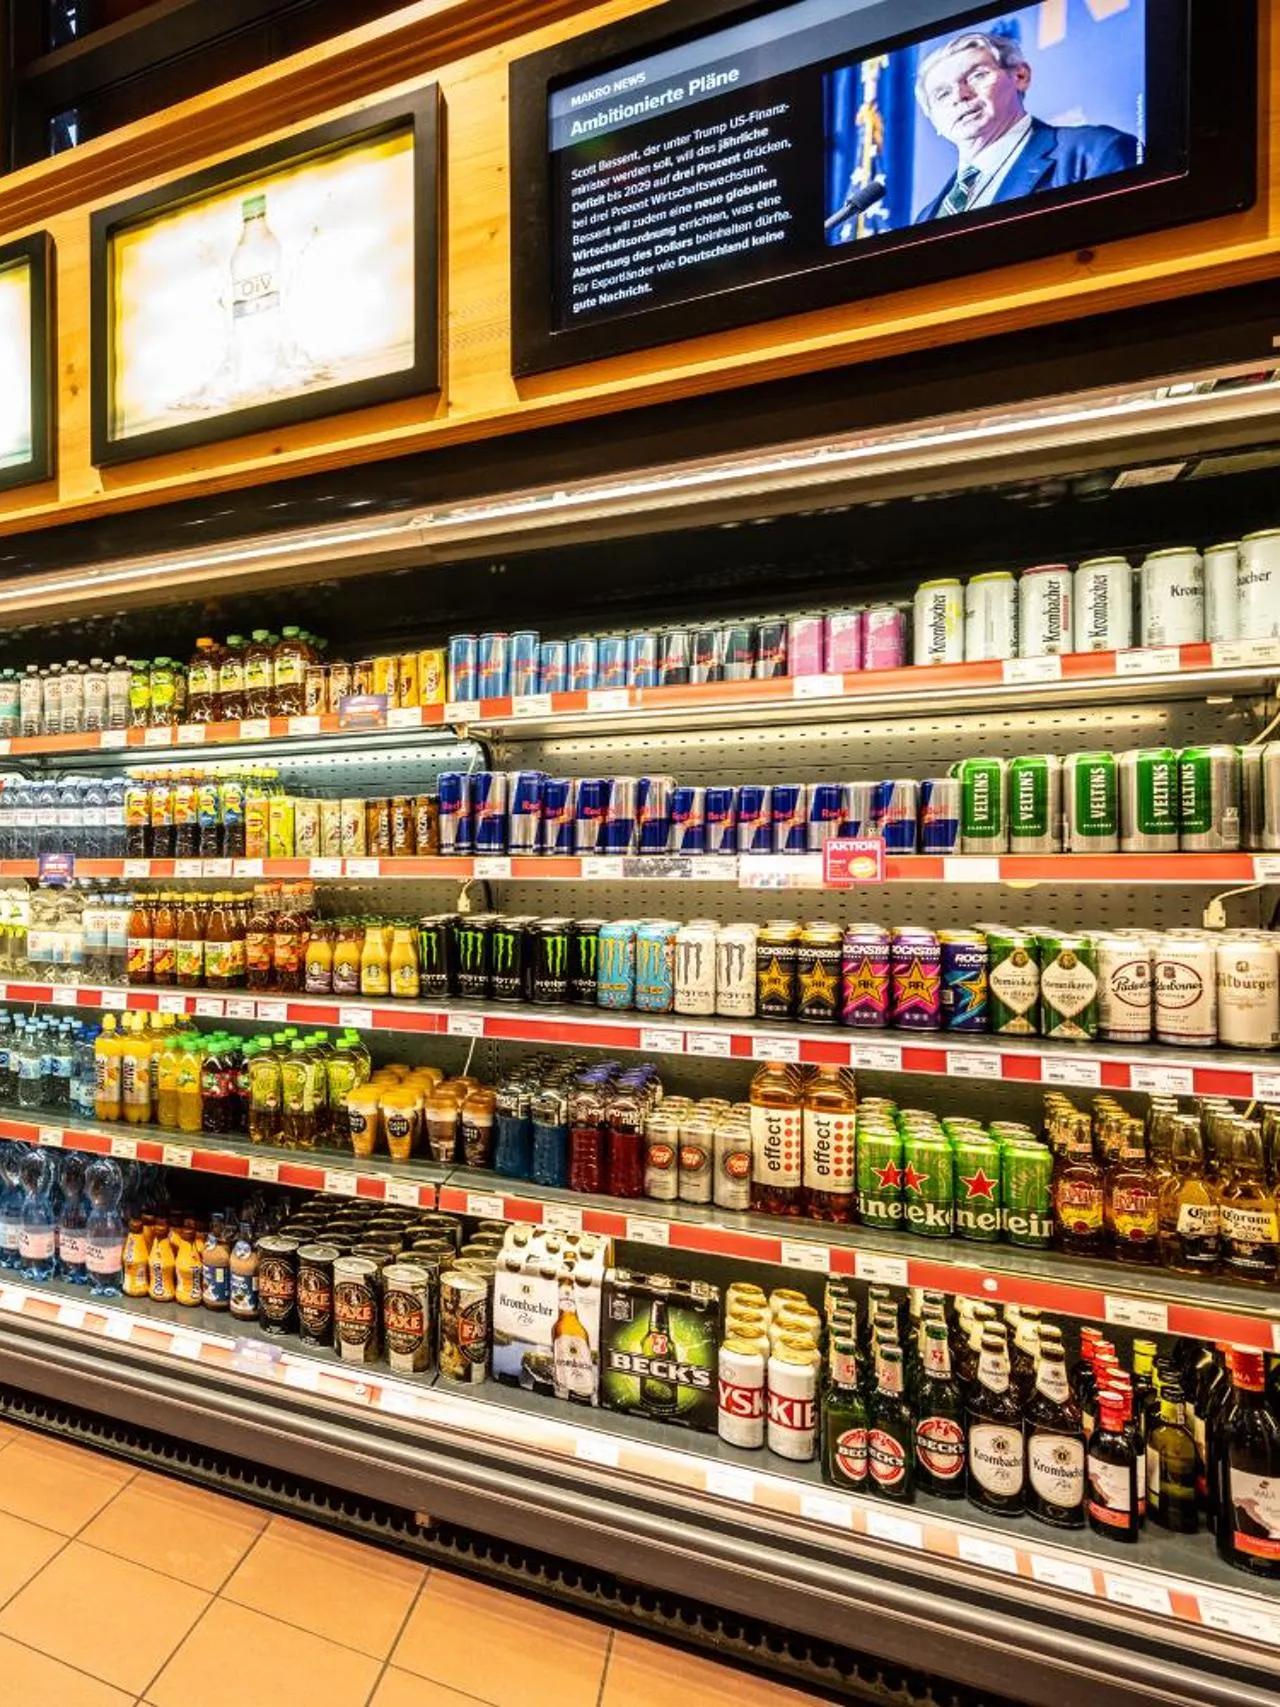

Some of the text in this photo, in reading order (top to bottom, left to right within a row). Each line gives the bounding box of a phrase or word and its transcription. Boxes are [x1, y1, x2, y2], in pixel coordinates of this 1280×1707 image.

[570, 69, 740, 137] Ambitionierte Pläne
[571, 72, 646, 107] MAKRO NEWS
[571, 164, 596, 180] Scott
[643, 143, 661, 157] der
[663, 134, 691, 150] unter
[693, 122, 727, 140] Trump
[729, 103, 789, 129] US-Finanz-
[571, 177, 611, 197] minister
[612, 164, 651, 183] werden
[676, 149, 694, 163] will
[696, 143, 716, 156] das
[718, 127, 769, 153] jährliche
[572, 195, 605, 213] Defizit
[607, 190, 622, 202] bis
[624, 180, 651, 197] 2029
[653, 173, 670, 188] auf
[672, 165, 694, 182] drei
[696, 153, 740, 175] Prozent
[572, 164, 767, 230] bei drei Prozent Wirtschaftswachstum.
[572, 179, 777, 246] Bessent will zudem eine neue globalen
[572, 225, 677, 262] Wirtschaftsordnung
[731, 202, 754, 217] was
[757, 195, 782, 209] eine
[572, 255, 630, 279] Abwertung
[632, 249, 652, 262] des
[654, 237, 693, 256] Dollars
[695, 221, 752, 245] beinhalten
[572, 230, 785, 295] Für Exportländer wie Deutschland keine
[572, 283, 653, 314] gute Nachricht.
[1042, 579, 1061, 643] Krombacher
[1088, 574, 1108, 638] Krombacher
[1170, 584, 1205, 597] Krom
[974, 772, 989, 821] VELTINS
[1020, 771, 1035, 821] VELTINS
[1090, 767, 1106, 818] VELTINS
[1153, 764, 1169, 817] VELTINS
[1182, 764, 1195, 817] VELTINS
[829, 840, 878, 851] AKTION
[955, 954, 987, 963] ROCK
[767, 1116, 781, 1172] effect
[816, 1120, 831, 1176] effect
[859, 1193, 903, 1220] ine
[336, 1306, 372, 1320] FAXE
[499, 1293, 554, 1317] Krombacher
[611, 1353, 711, 1387] BECK'S
[838, 1446, 868, 1456] BEC
[974, 1447, 1022, 1467] Krombach
[1033, 1457, 1084, 1478] Krombach
